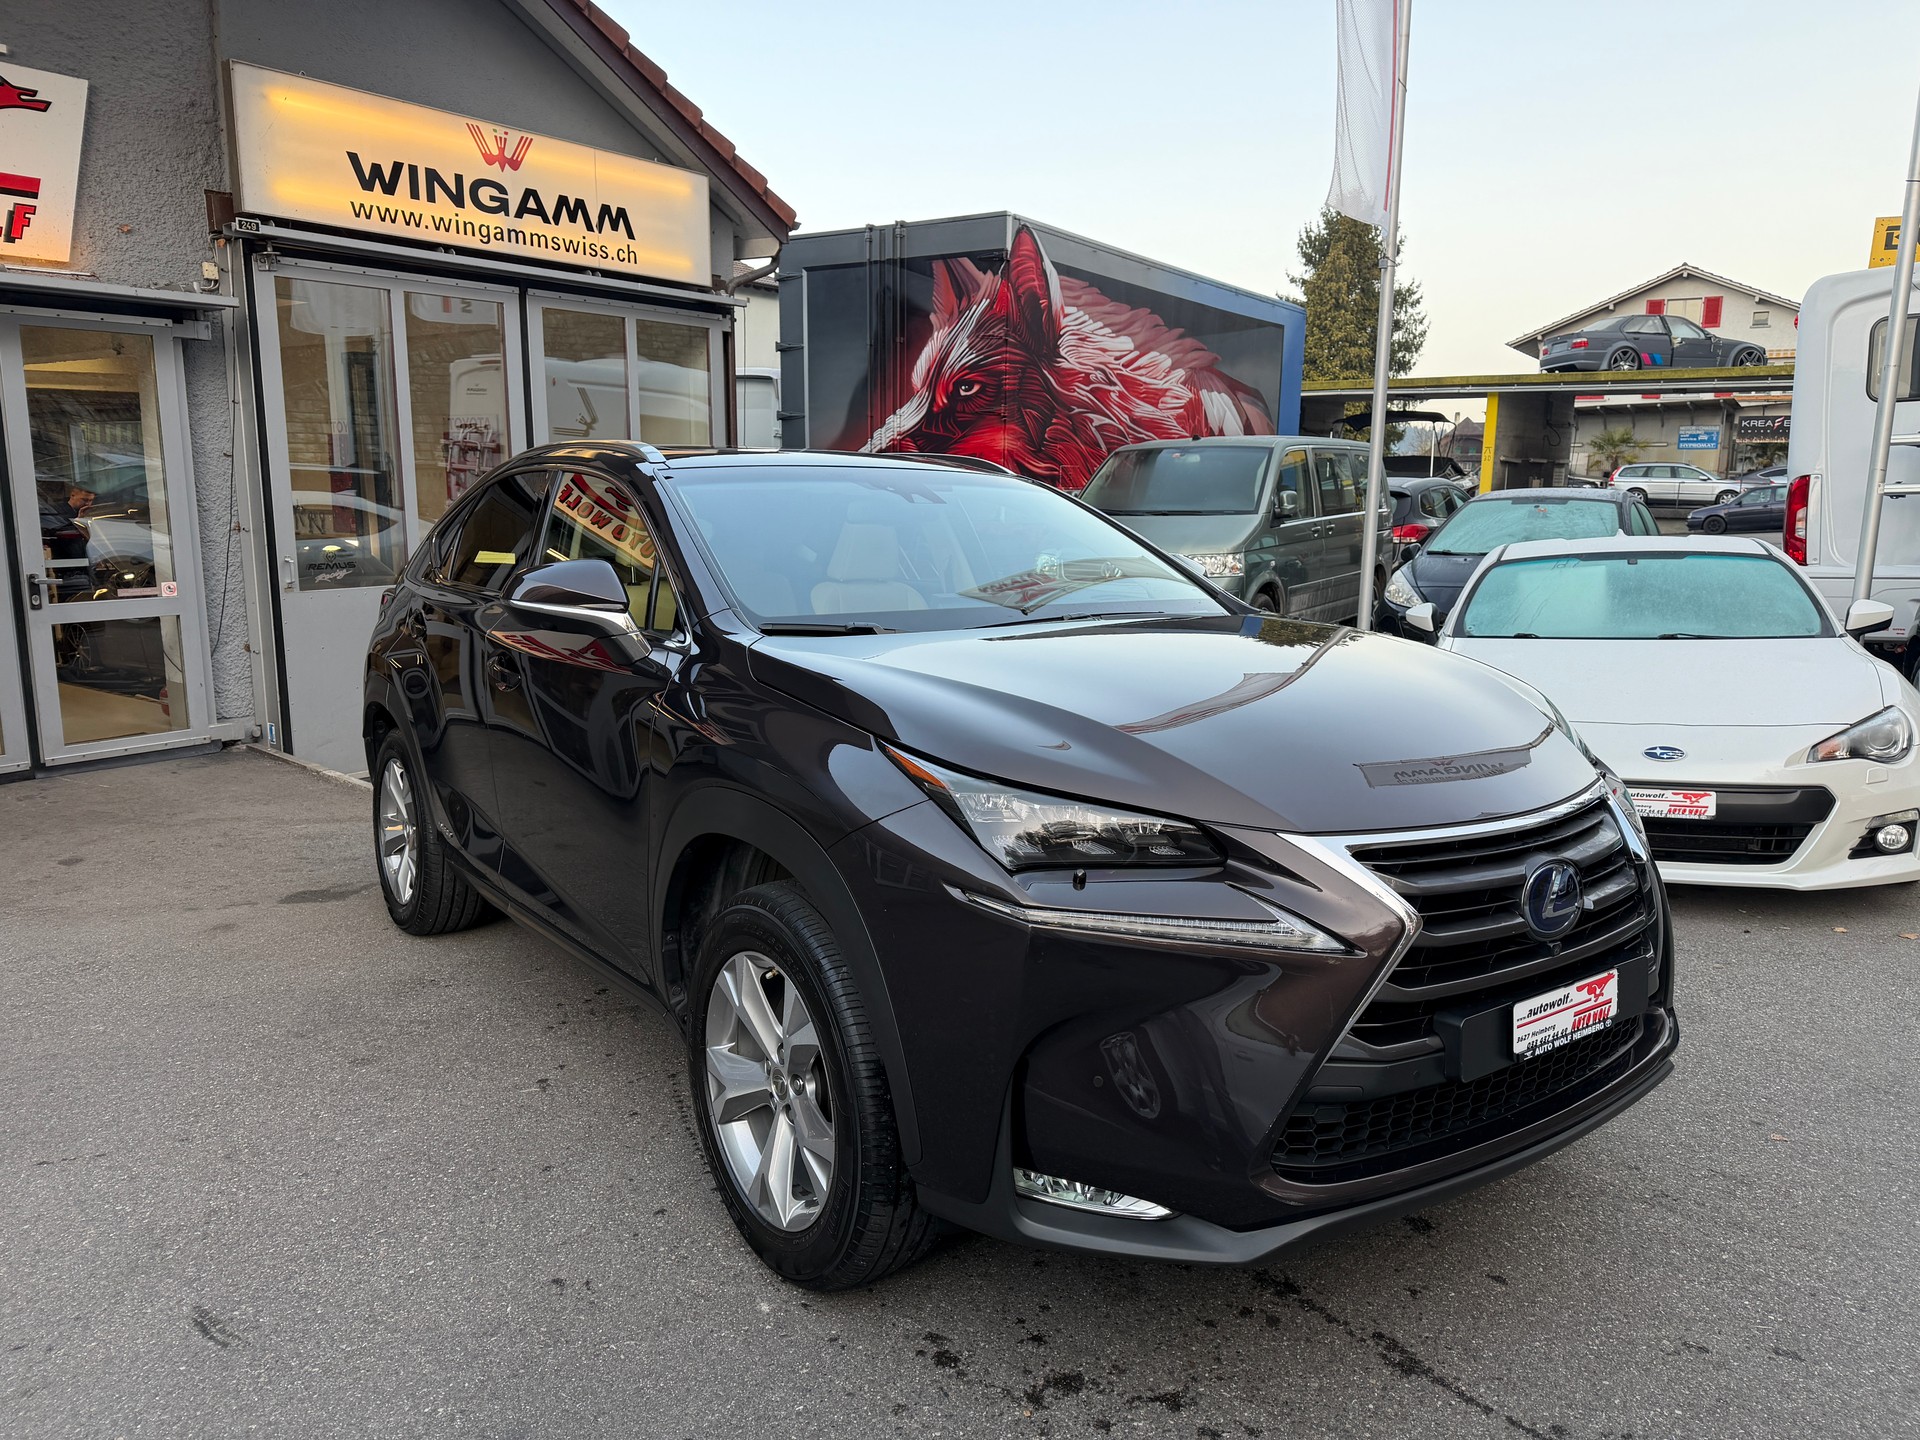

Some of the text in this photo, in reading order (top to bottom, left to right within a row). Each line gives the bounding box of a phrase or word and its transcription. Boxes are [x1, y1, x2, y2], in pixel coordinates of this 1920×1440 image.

[346, 151, 636, 241] WINGAMM
[241, 220, 257, 231] 249
[350, 200, 638, 266] www.wingammswiss.ch
[306, 561, 357, 571] REMUS
[1531, 1024, 1556, 1038] Heimberg
[1571, 1005, 1612, 1032] AUTO WOLF
[1535, 1022, 1604, 1056] AUTO WOLF HEIMBERG
